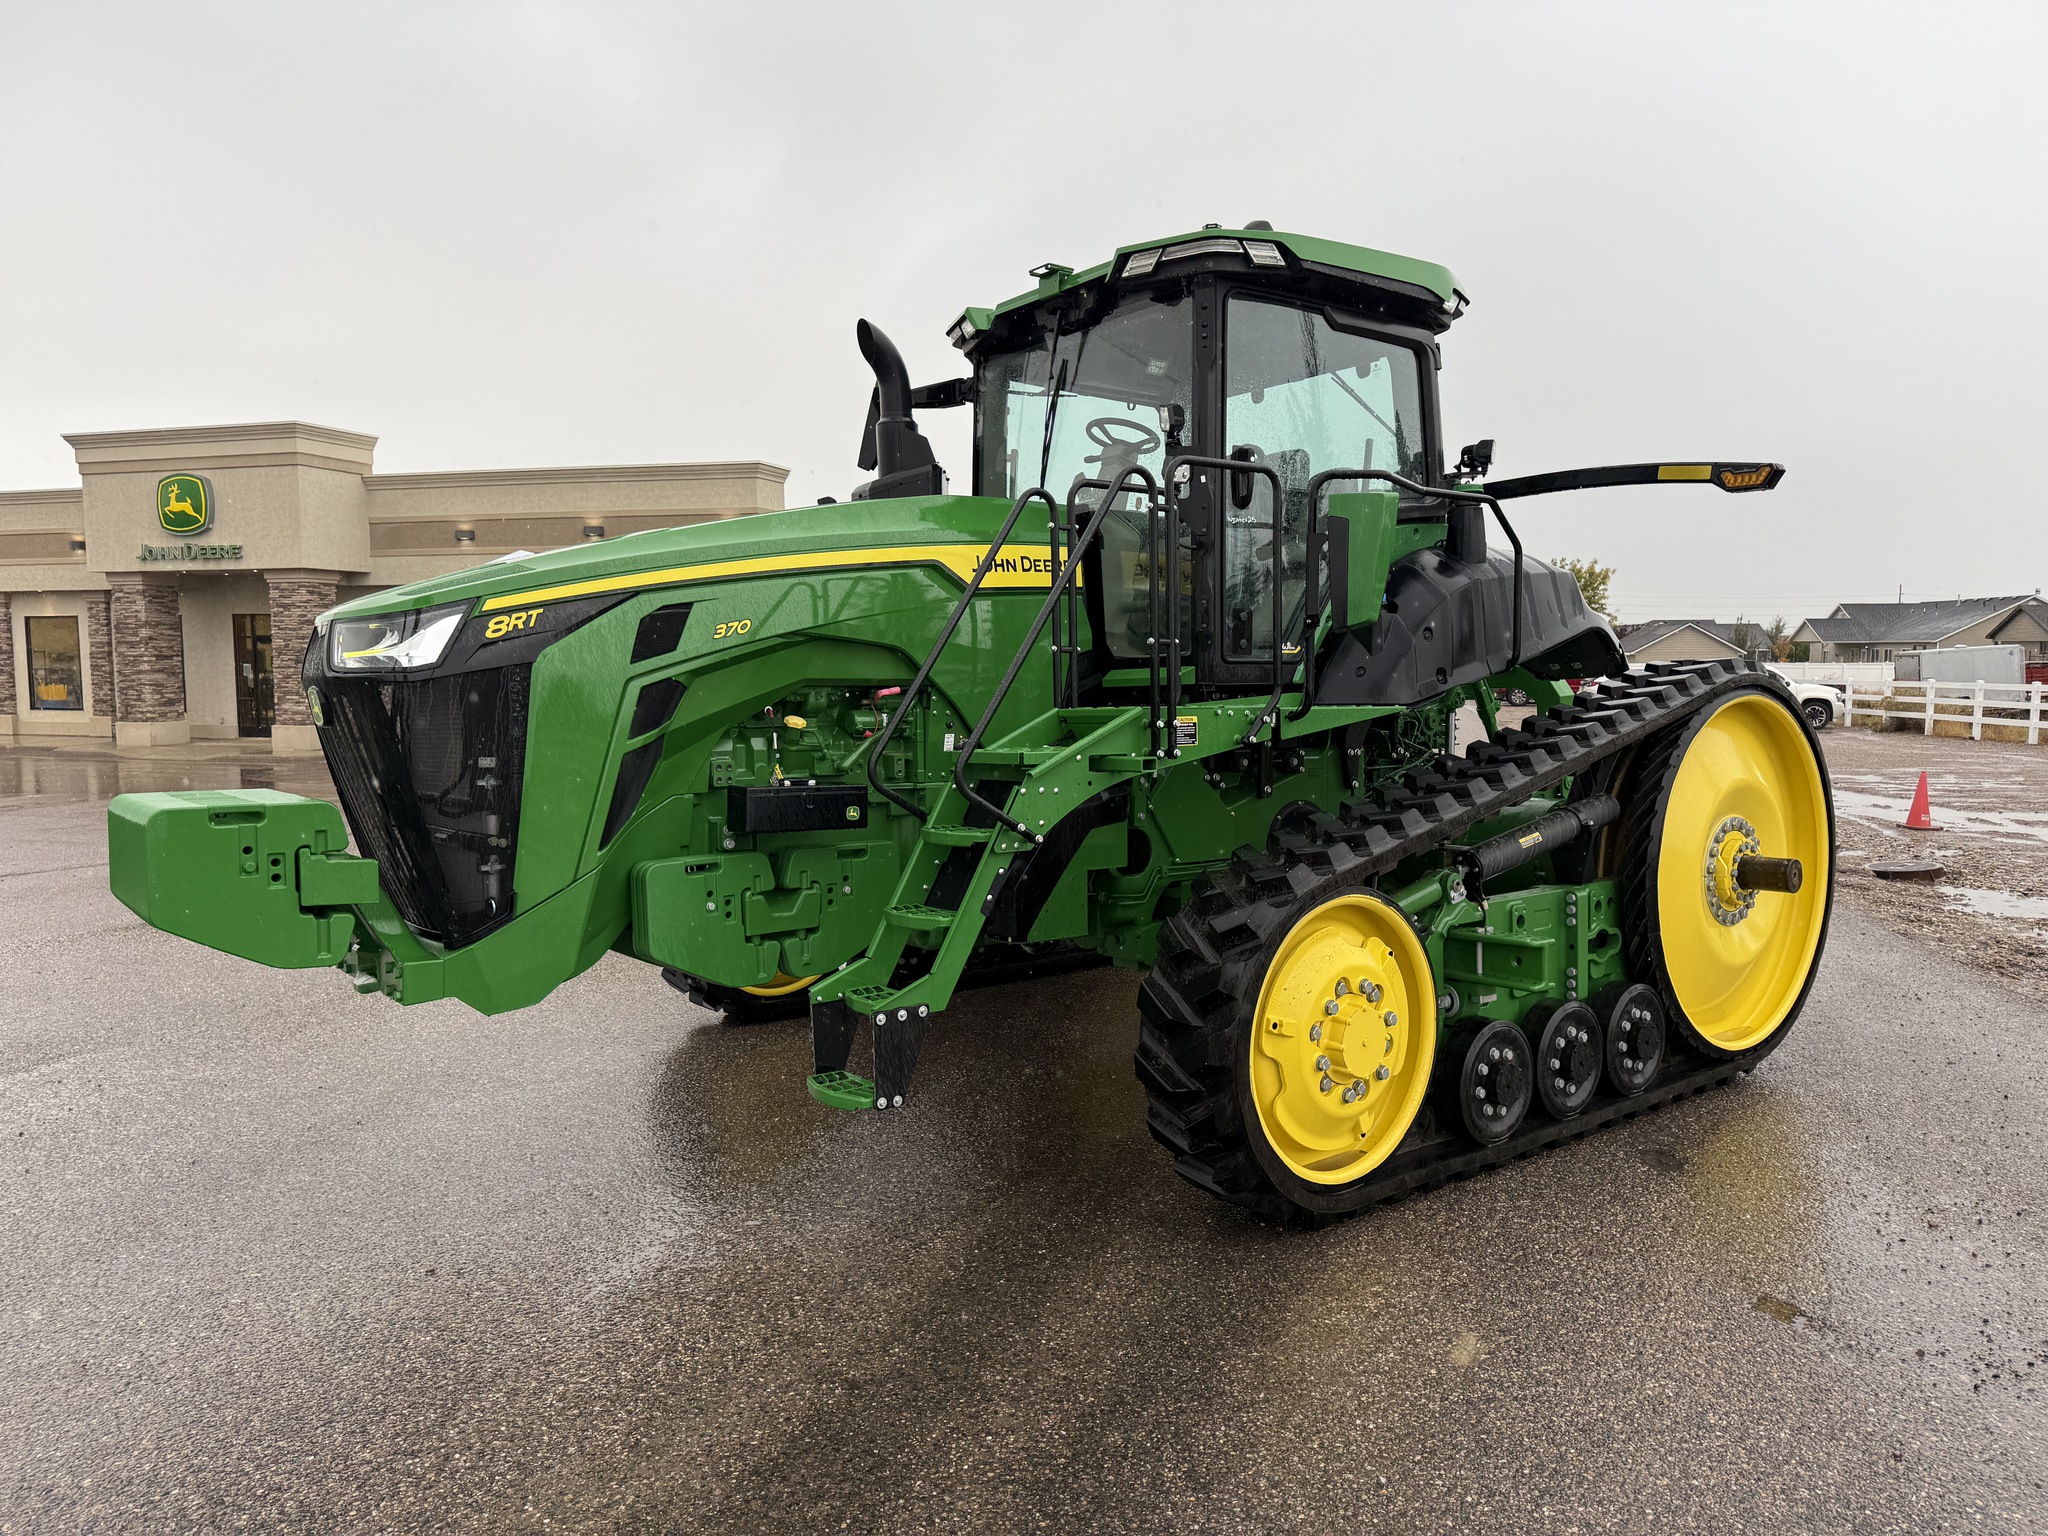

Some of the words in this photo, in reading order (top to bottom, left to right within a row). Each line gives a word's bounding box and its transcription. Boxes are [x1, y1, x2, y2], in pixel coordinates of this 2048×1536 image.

[136, 544, 182, 560] JOHN
[183, 542, 243, 560] DEERE
[485, 608, 544, 639] 8RT
[713, 619, 752, 639] 370
